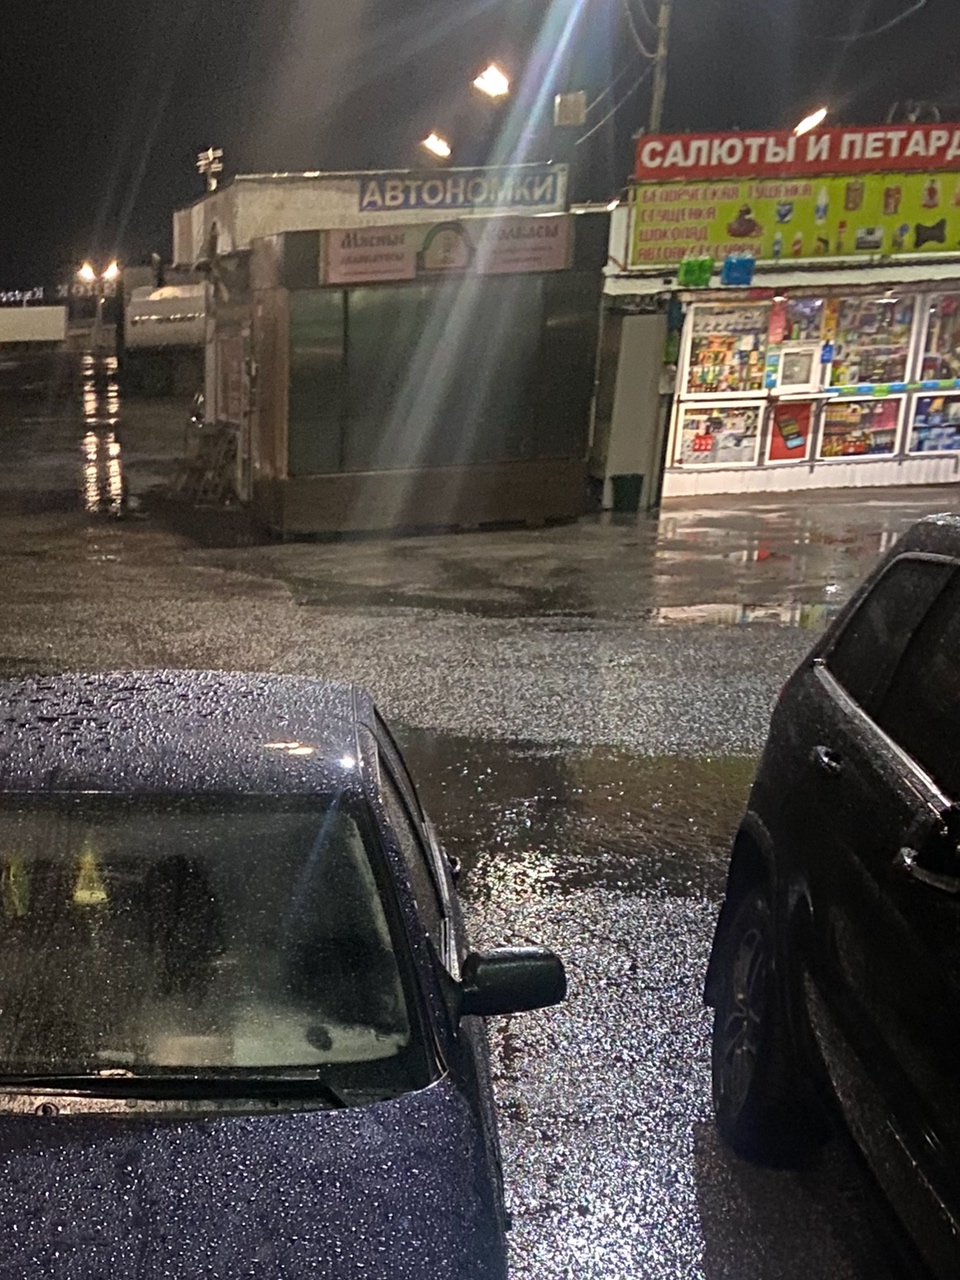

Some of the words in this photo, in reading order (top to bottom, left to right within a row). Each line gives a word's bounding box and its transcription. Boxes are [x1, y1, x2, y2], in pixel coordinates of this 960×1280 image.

[640, 136, 796, 168] САЛЮТЫ
[806, 134, 831, 162] И
[361, 176, 554, 207] АВТОНОМКИ
